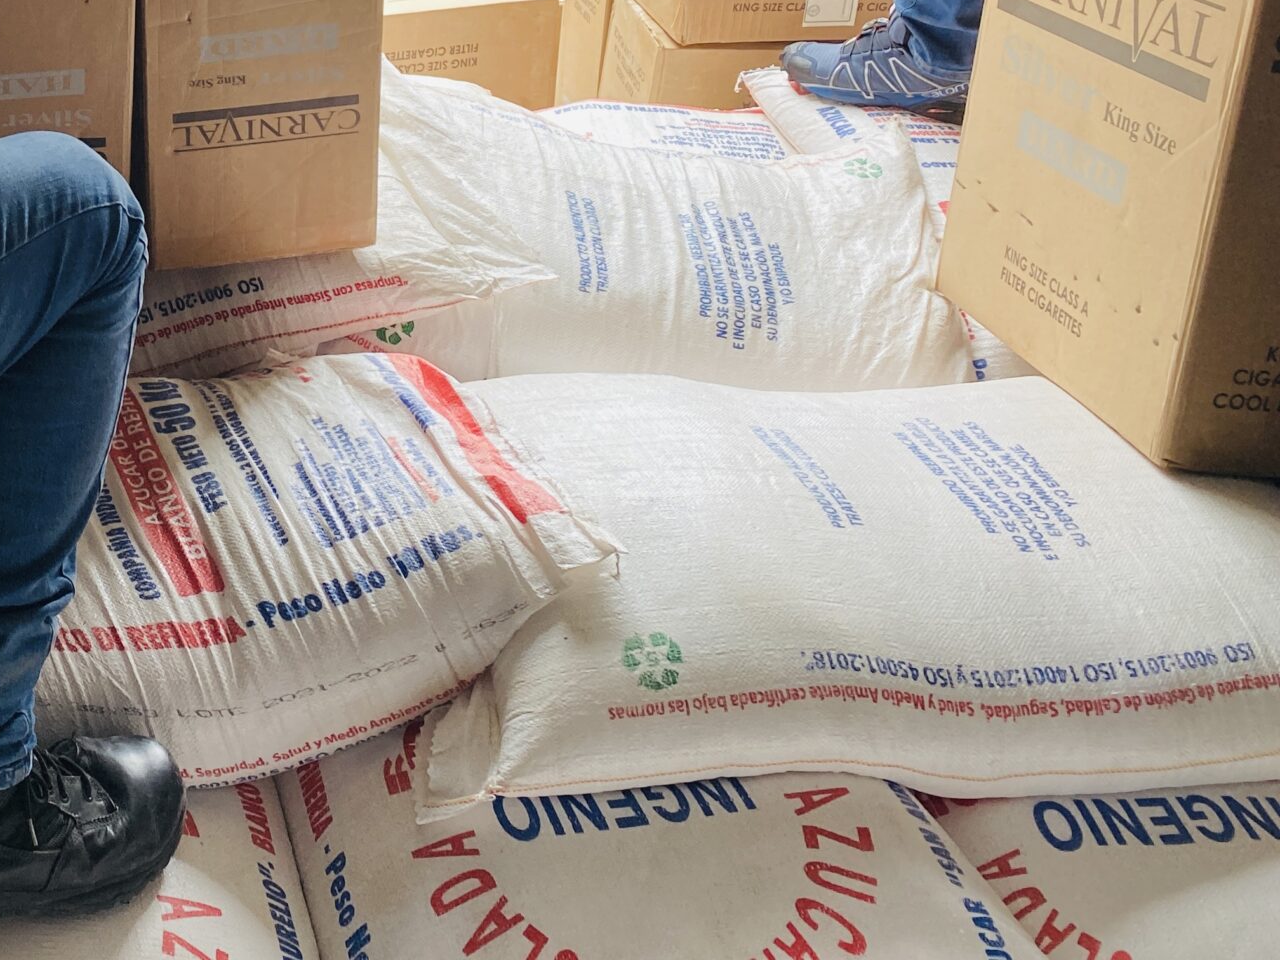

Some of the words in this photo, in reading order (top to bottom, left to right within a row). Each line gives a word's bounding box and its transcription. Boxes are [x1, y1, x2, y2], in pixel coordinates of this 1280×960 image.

[732, 3, 760, 12] KING
[762, 3, 783, 12] SIZE
[450, 43, 479, 54] FILTER
[427, 60, 449, 72] SIZE
[452, 57, 478, 69] KING
[188, 75, 213, 90] Size
[217, 73, 247, 89] King
[1, 108, 92, 131] Silver
[173, 107, 362, 150] CARNIVAL
[816, 106, 857, 139] AZUCAR
[1103, 99, 1140, 143] King
[1143, 118, 1178, 156] Size
[739, 249, 752, 262] SE
[768, 242, 792, 288] EMPAQUE
[577, 243, 593, 293] PRODUCTO
[597, 260, 609, 293] TRATESE
[725, 269, 741, 281] DE
[744, 262, 758, 282] QUE
[238, 277, 264, 294] ISO
[334, 285, 354, 297] con
[695, 263, 713, 318] PROHIBIDO
[710, 257, 729, 305] GARANTIZA
[1004, 244, 1028, 272] KING
[1028, 262, 1048, 287] SIZE
[1049, 277, 1080, 310] CLASS
[1080, 300, 1089, 318] A
[154, 288, 233, 318] 9001:2015,
[288, 289, 332, 306] Sistema
[748, 285, 762, 315] CASO
[1000, 266, 1026, 296] FILTER
[1027, 286, 1083, 338] CIGARETTES
[214, 311, 230, 322] de
[230, 298, 286, 319] Integrado
[716, 304, 729, 320] SE
[726, 281, 746, 341] INOCUIDAD
[156, 326, 170, 340] de
[170, 313, 214, 335] Gestión
[716, 320, 729, 339] NO
[751, 315, 762, 330] EN
[767, 327, 778, 341] SU
[733, 342, 745, 350] E
[1213, 391, 1266, 412] COOL
[149, 403, 196, 434] 50
[133, 440, 157, 464] DE
[171, 436, 209, 470] NETO
[239, 462, 252, 472] 2
[118, 454, 163, 525] AZUCAR
[191, 470, 228, 514] PESO
[148, 468, 207, 561] BLANCO
[942, 478, 1000, 535] PROHIBIDO
[1015, 492, 1050, 523] CASO
[995, 492, 1054, 553] INOCUIDAD
[1001, 519, 1020, 534] SE
[1044, 523, 1063, 538] EN
[1012, 534, 1034, 554] NO
[1070, 532, 1091, 548] SU
[124, 615, 247, 654] REFINERIA
[257, 593, 322, 630] Peso
[322, 571, 387, 608] Neto
[1119, 649, 1219, 676] 9001:2015,
[1224, 642, 1256, 663] ISO
[923, 666, 954, 689] ISO
[957, 664, 966, 685] y
[973, 665, 1079, 689] 14001:2015
[1083, 662, 1117, 683] ISO
[729, 687, 807, 711] certificada
[809, 684, 879, 704] Ambiente
[881, 690, 927, 711] Medio
[1123, 693, 1142, 708] de
[1145, 687, 1195, 708] Gestión
[1196, 683, 1214, 698] de
[608, 701, 665, 720] normas
[668, 699, 691, 714] las
[693, 693, 728, 712] bajo
[928, 697, 936, 711] y
[937, 699, 975, 718] Salud
[980, 700, 1059, 722] Seguridad,
[1059, 695, 1121, 716] Calidad,
[195, 756, 270, 779] Seguridad,
[272, 741, 312, 764] Salud
[313, 739, 322, 749] y
[324, 724, 368, 745] Medio
[369, 697, 434, 729] Ambiente
[493, 777, 758, 843] INGENIO
[325, 851, 356, 927] Peso
